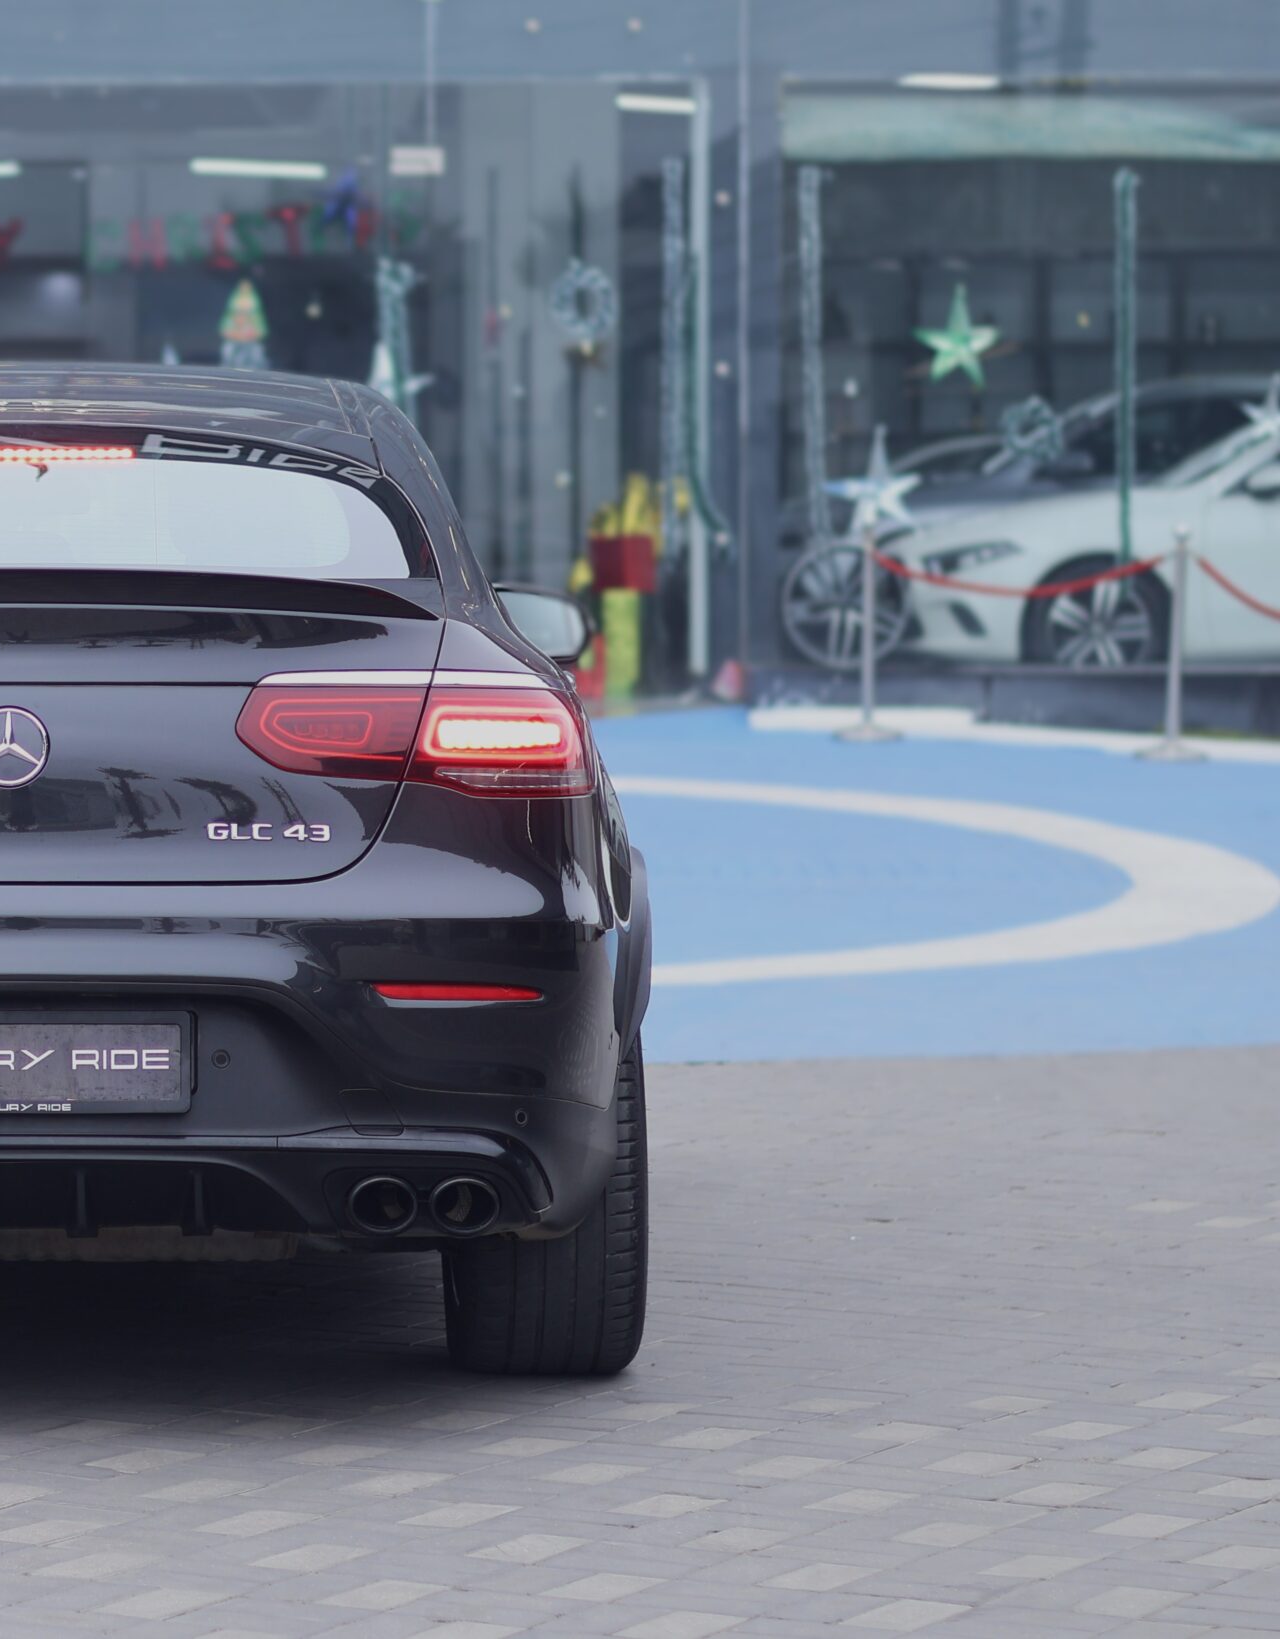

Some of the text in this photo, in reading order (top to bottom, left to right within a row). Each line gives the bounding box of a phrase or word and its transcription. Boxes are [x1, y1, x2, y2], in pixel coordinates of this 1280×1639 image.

[207, 823, 331, 842] GLC 43
[71, 1048, 171, 1071] RIDE
[37, 1102, 72, 1113] RIDE
